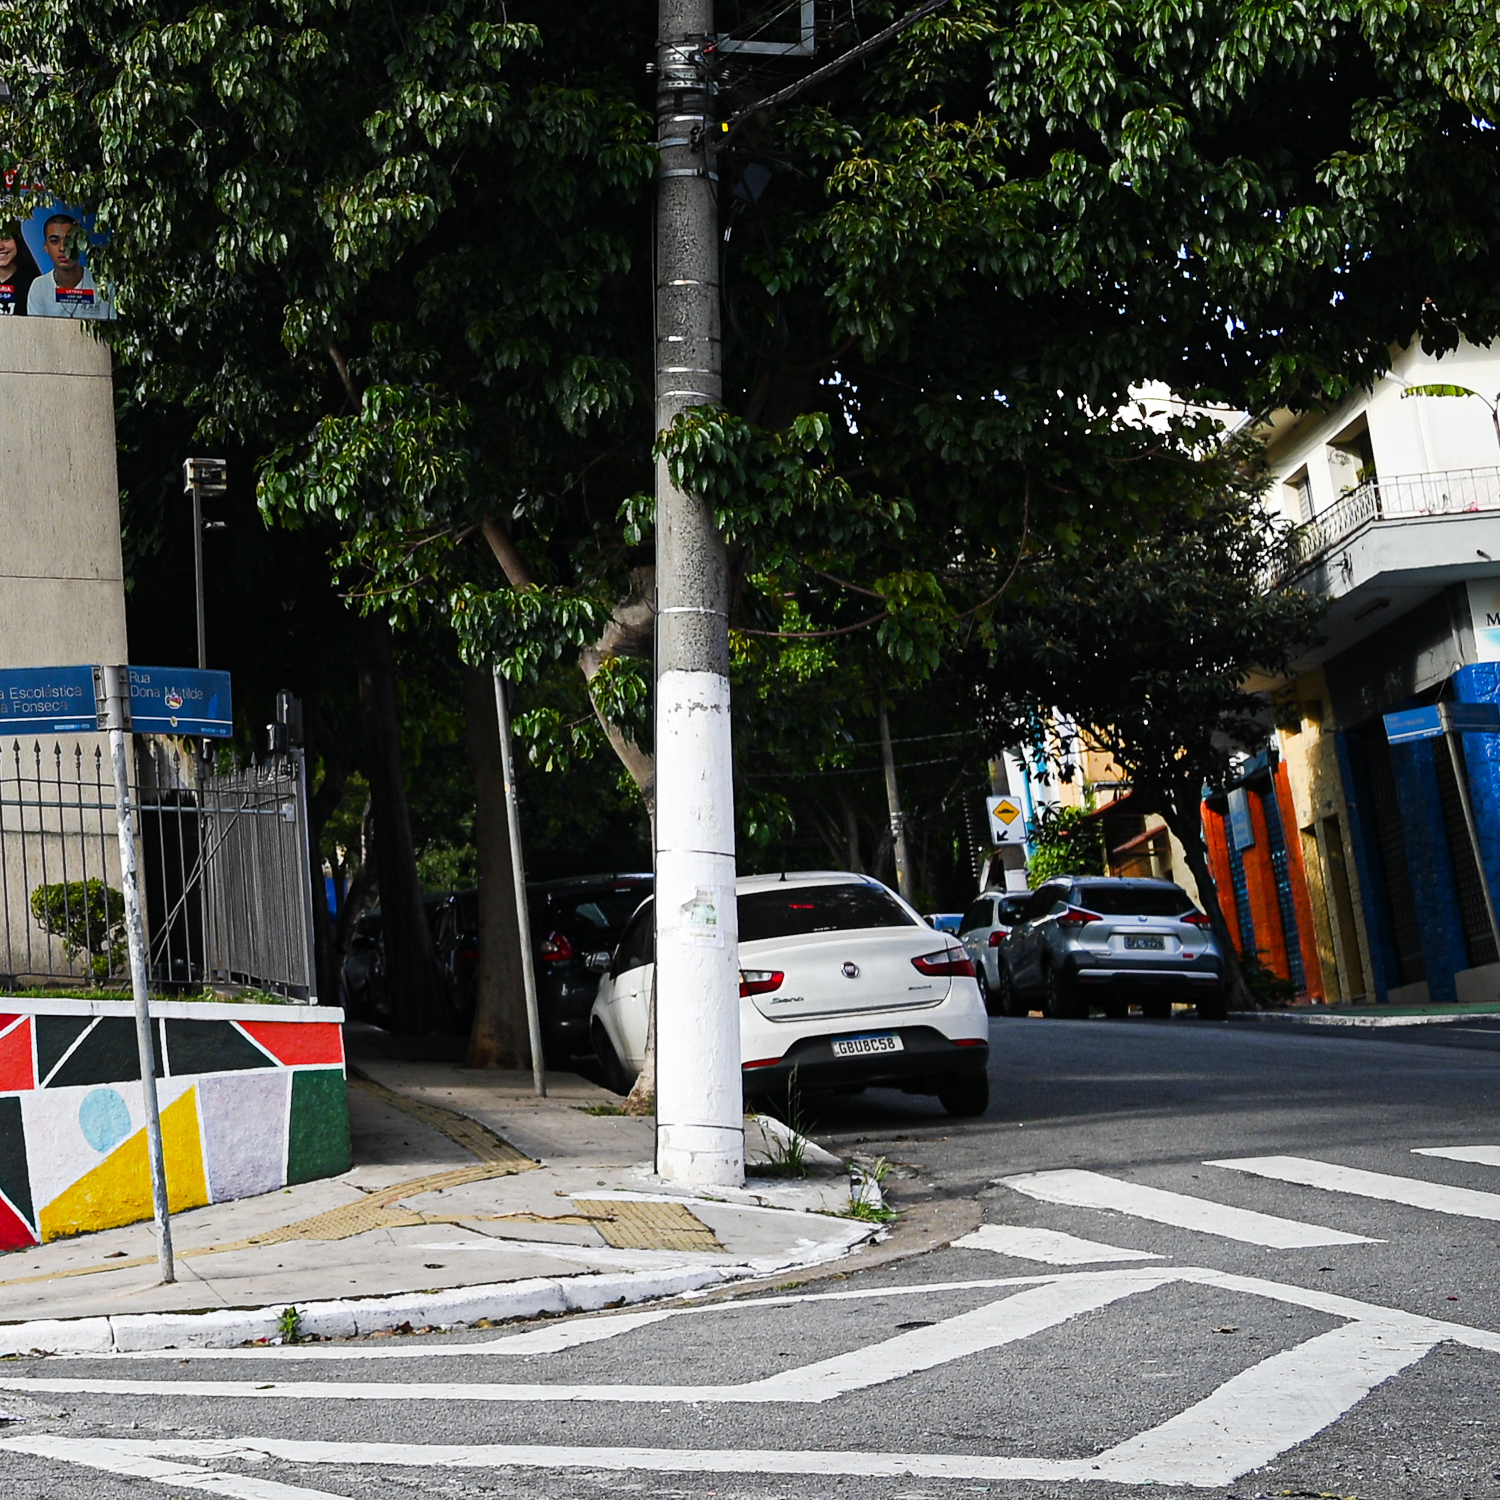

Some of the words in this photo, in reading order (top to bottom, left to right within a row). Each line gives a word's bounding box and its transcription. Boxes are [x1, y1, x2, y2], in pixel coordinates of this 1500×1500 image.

[129, 671, 150, 684] Rua
[9, 684, 83, 700] Escolástica
[130, 685, 160, 698] Dona
[13, 700, 68, 714] Fonseca
[838, 1037, 896, 1055] GBU8C58
